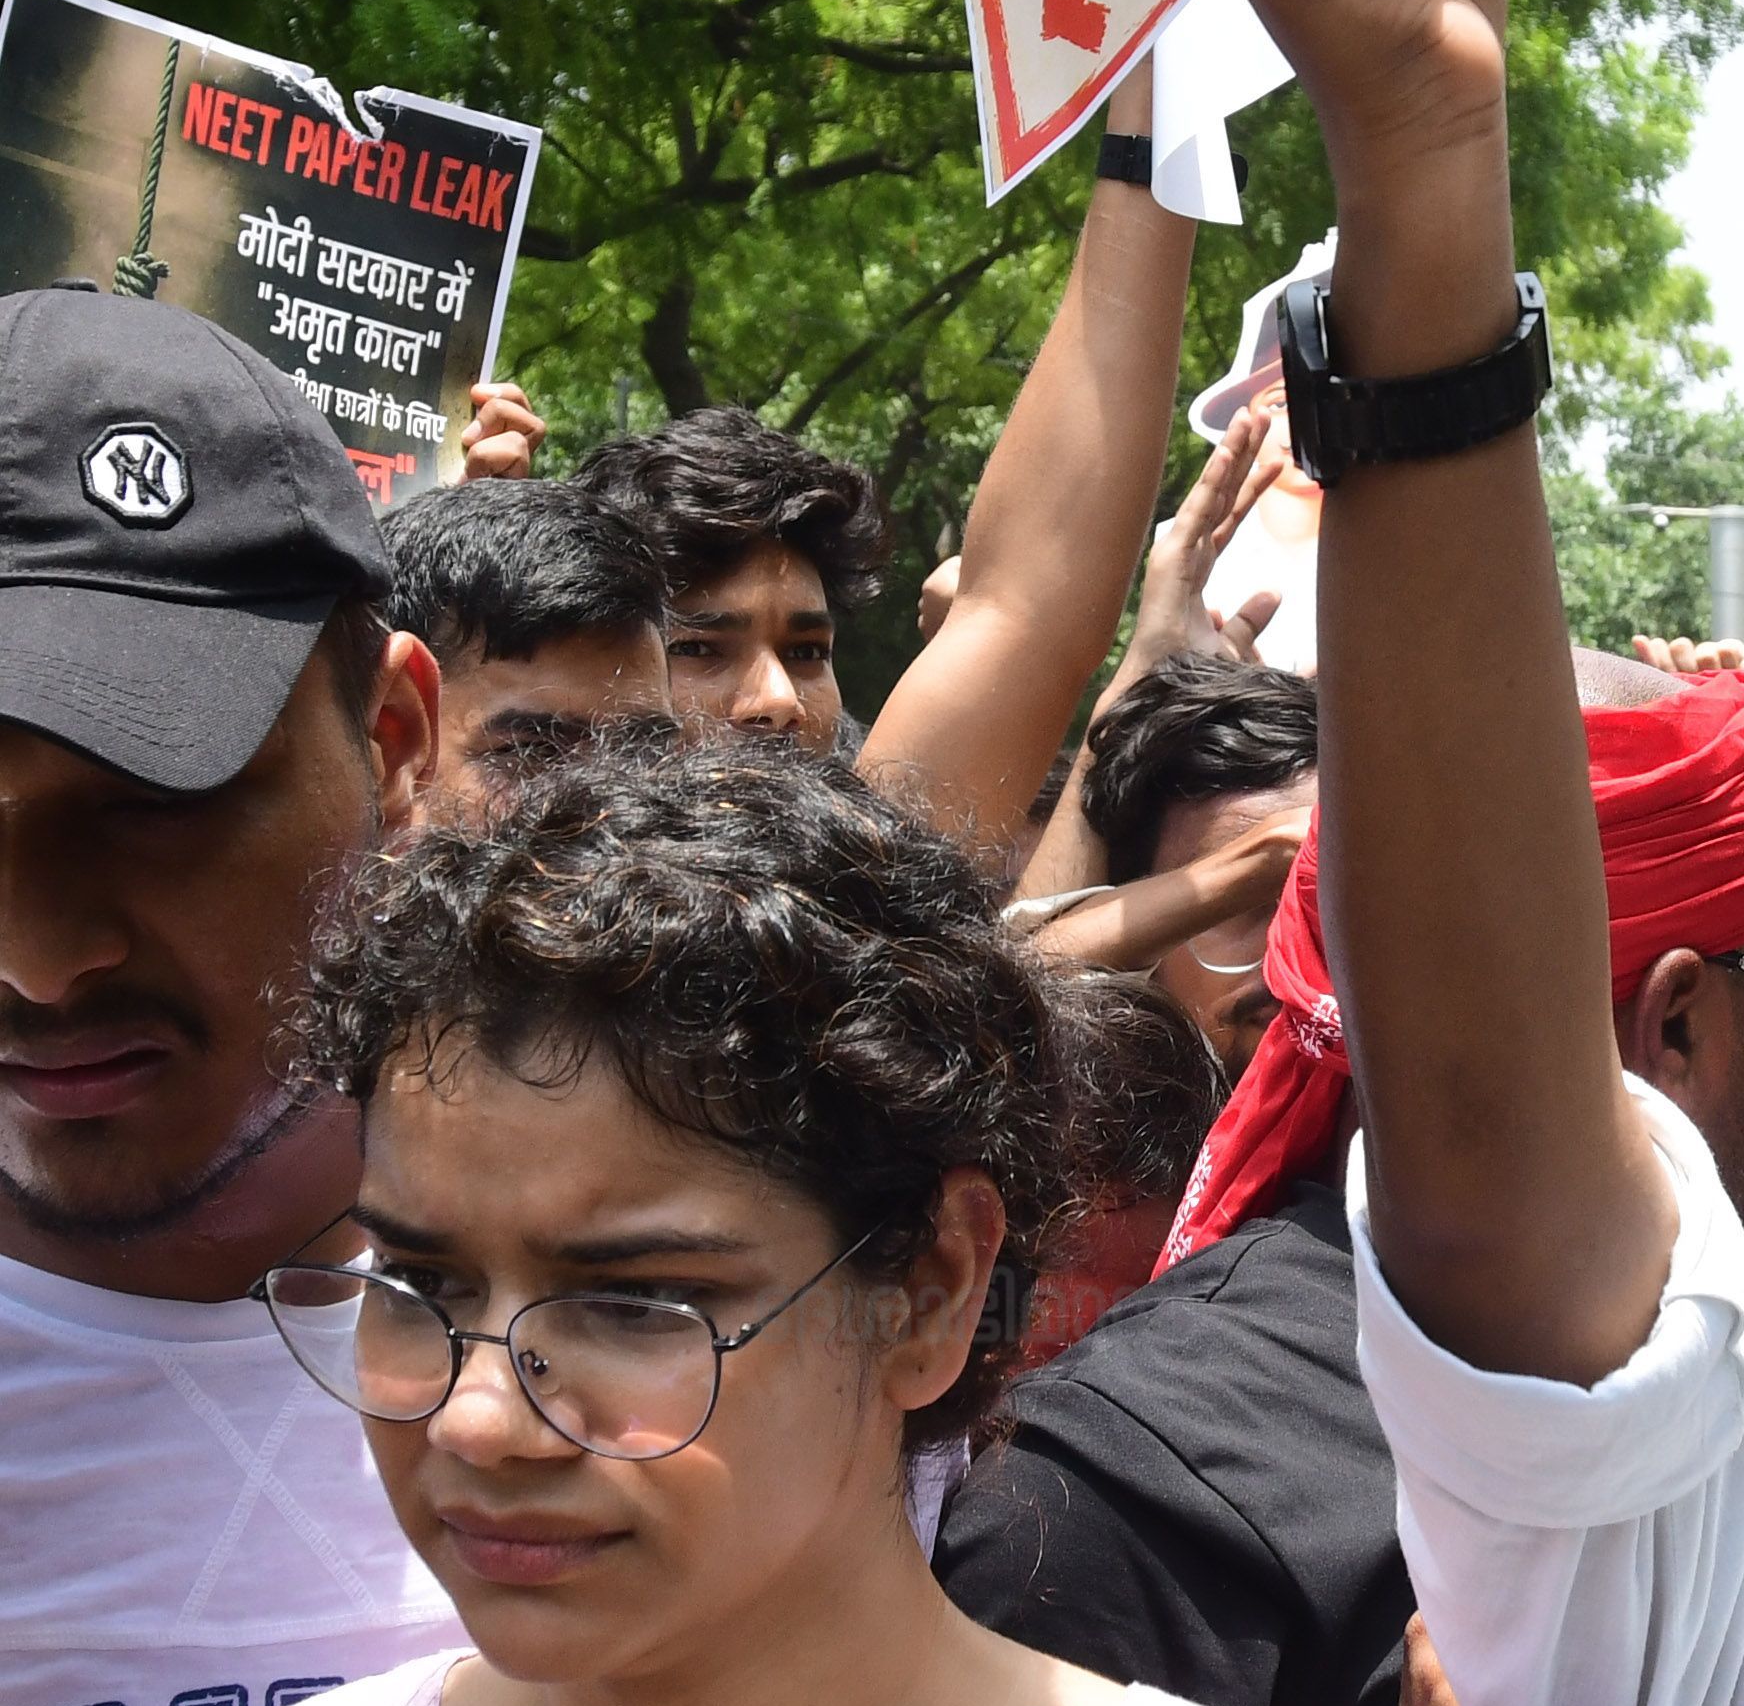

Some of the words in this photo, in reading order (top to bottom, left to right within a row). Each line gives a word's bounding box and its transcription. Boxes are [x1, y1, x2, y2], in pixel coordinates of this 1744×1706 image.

[182, 81, 283, 167] NEET
[284, 113, 407, 205] PAPER
[410, 149, 515, 232] LEAK
[237, 204, 314, 278] मोदी
[316, 236, 434, 312] सरकार
[435, 258, 476, 322] में
[381, 392, 404, 432] के
[404, 400, 449, 444] लिए
